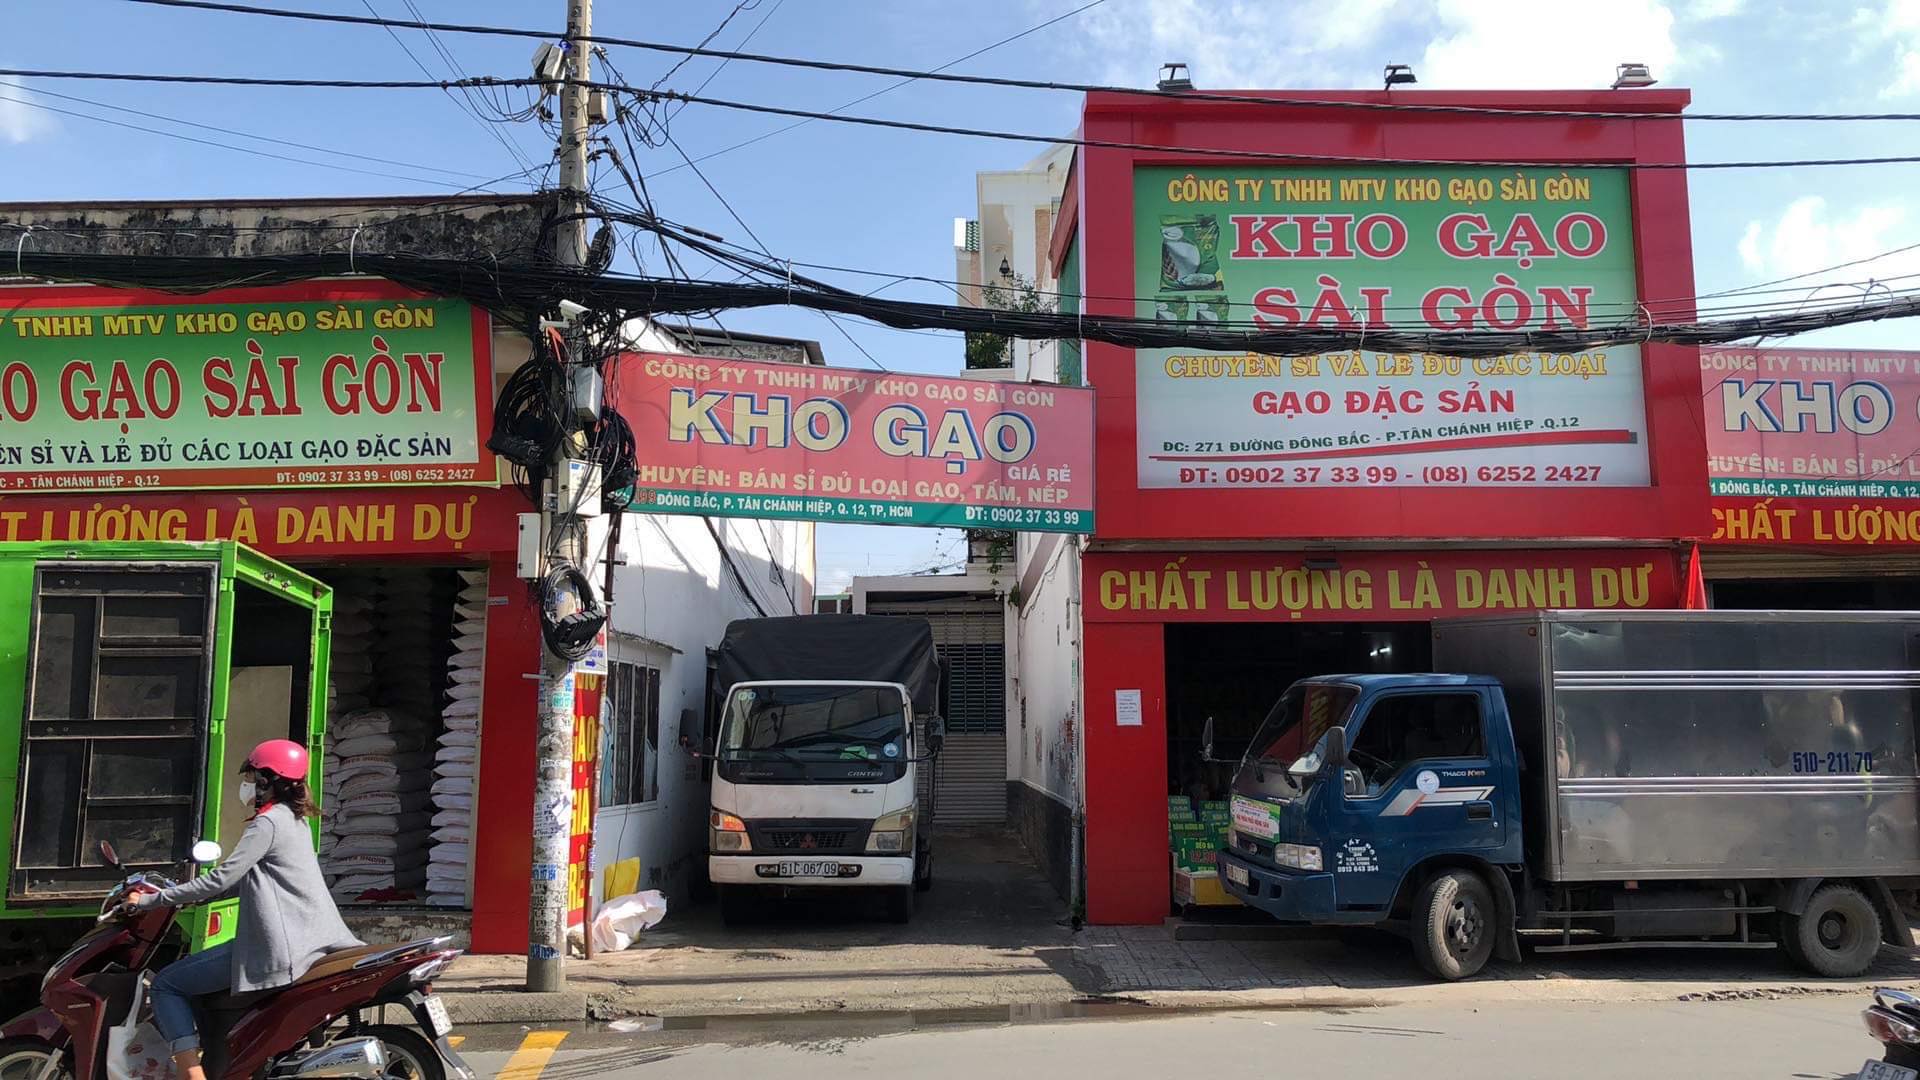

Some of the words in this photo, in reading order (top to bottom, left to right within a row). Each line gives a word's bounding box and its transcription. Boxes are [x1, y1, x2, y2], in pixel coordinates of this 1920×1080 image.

[1167, 173, 1229, 202] CÔNG
[1234, 179, 1262, 201] TY
[1270, 179, 1332, 201] TNHH
[1339, 179, 1388, 201] MTV
[1394, 178, 1441, 201] KHO
[1447, 179, 1494, 206] GẠO
[1499, 173, 1537, 201] SÀI
[1544, 173, 1591, 201] GÒN
[1229, 213, 1408, 260] KHO
[1437, 212, 1608, 270] GẠO
[1251, 273, 1392, 331] SÀI
[1420, 272, 1595, 331] GÒN
[13, 315, 93, 337] TNHH
[104, 314, 166, 336] MTV
[175, 312, 238, 334] KHO
[246, 311, 306, 335] GẠO
[316, 305, 364, 330] SÀI
[373, 303, 435, 329] GÒN
[1539, 353, 1608, 380] LOẠI
[1700, 354, 1757, 370] CÔNG
[1765, 357, 1790, 372] TY
[1796, 357, 1856, 373] TNHH
[1864, 358, 1906, 373] MTV
[0, 361, 39, 423] O
[59, 358, 182, 434] GẠO
[202, 338, 302, 419] SÀI
[321, 335, 445, 416] GÒN
[645, 359, 711, 380] CÔNG
[718, 366, 747, 383] TY
[754, 369, 815, 389] TNHH
[822, 375, 866, 393] MTV
[874, 380, 919, 398] KHO
[924, 384, 968, 404] GẠO
[973, 384, 1005, 403] SÀI
[1012, 387, 1055, 407] GÒN
[1252, 389, 1332, 420] GẠO
[1344, 386, 1425, 420] ĐẶC
[1437, 381, 1516, 414] SẢN
[1721, 378, 1895, 435] KHO
[667, 385, 851, 452] KHO
[872, 402, 1037, 476] GẠO
[1162, 441, 1190, 453] ĐC:
[1194, 441, 1223, 453] 271
[1230, 438, 1284, 452] ĐƯỜNG
[1289, 435, 1334, 449] ĐÔNG
[1338, 430, 1370, 446] BẮC
[1437, 422, 1491, 437] CHÁNH
[1497, 417, 1534, 432] HIỆP
[31, 439, 54, 464] SỈ
[60, 440, 95, 463] VÀ
[101, 438, 132, 463] LẺ
[140, 437, 172, 462] ĐỦ
[182, 438, 230, 461] CÁC
[238, 441, 293, 464] LOẠI
[301, 440, 348, 463] GẠO
[357, 434, 401, 461] ĐẶC
[408, 432, 452, 457] SẢN
[1792, 453, 1837, 474] BÁN
[1845, 453, 1866, 475] SỈ
[17, 478, 29, 488] P.
[30, 475, 53, 488] TÂN
[56, 474, 94, 487] CHÁNH
[98, 474, 125, 488] HIỆP
[135, 475, 160, 487] Q.12
[276, 472, 296, 482] ĐT:
[298, 471, 328, 482] 0902
[329, 471, 345, 482] 37
[346, 470, 361, 481] 33
[364, 470, 379, 481] 99
[390, 469, 412, 482] (08)
[415, 469, 444, 480] 6252
[447, 468, 475, 479] 2427
[640, 465, 731, 486] HUYÊN:
[739, 468, 786, 489] BÁN
[793, 469, 814, 491] SỈ
[821, 471, 852, 493] ĐỦ
[859, 478, 908, 500] LOẠI
[915, 481, 966, 502] GẠO,
[972, 480, 1021, 505] TẤM,
[1027, 480, 1069, 503] NẾP
[1007, 464, 1041, 482] GIÁ
[1047, 464, 1071, 482] RẺ
[1179, 467, 1217, 483] ĐT:
[1225, 467, 1285, 483] 0902
[1293, 467, 1321, 482] 37
[1330, 467, 1359, 482] 33
[1366, 466, 1398, 483] 99
[1422, 466, 1468, 483] (08)
[1477, 466, 1536, 482] 6252
[1544, 466, 1602, 482] 2427
[1720, 482, 1750, 493] ĐÔNG
[1753, 482, 1778, 496] BẮC,
[1781, 484, 1792, 495] P.
[1794, 483, 1816, 495] TÂN
[1819, 483, 1856, 496] CHÁNH
[1890, 485, 1901, 497] Q.
[657, 492, 690, 507] ĐÔNG
[723, 499, 734, 509] P.
[738, 497, 760, 511] TÂN
[764, 498, 803, 512] CHÁNH
[806, 500, 834, 516] HIỆP,
[837, 503, 848, 515] Q.
[852, 504, 867, 517] 12,
[889, 506, 913, 518] HCM
[965, 506, 988, 523] ĐT:
[991, 508, 1022, 523] 0902
[1026, 508, 1041, 523] 37
[1045, 509, 1061, 524] 33
[1064, 510, 1080, 525] 99
[276, 504, 395, 544] DANH
[413, 495, 478, 549] DỰ
[1101, 556, 1212, 610] CHẤT
[1225, 566, 1373, 618] LƯỢNG
[1387, 561, 1443, 609] LÀ
[1456, 567, 1577, 609] DANH
[1792, 751, 1873, 773] 51D-211.70
